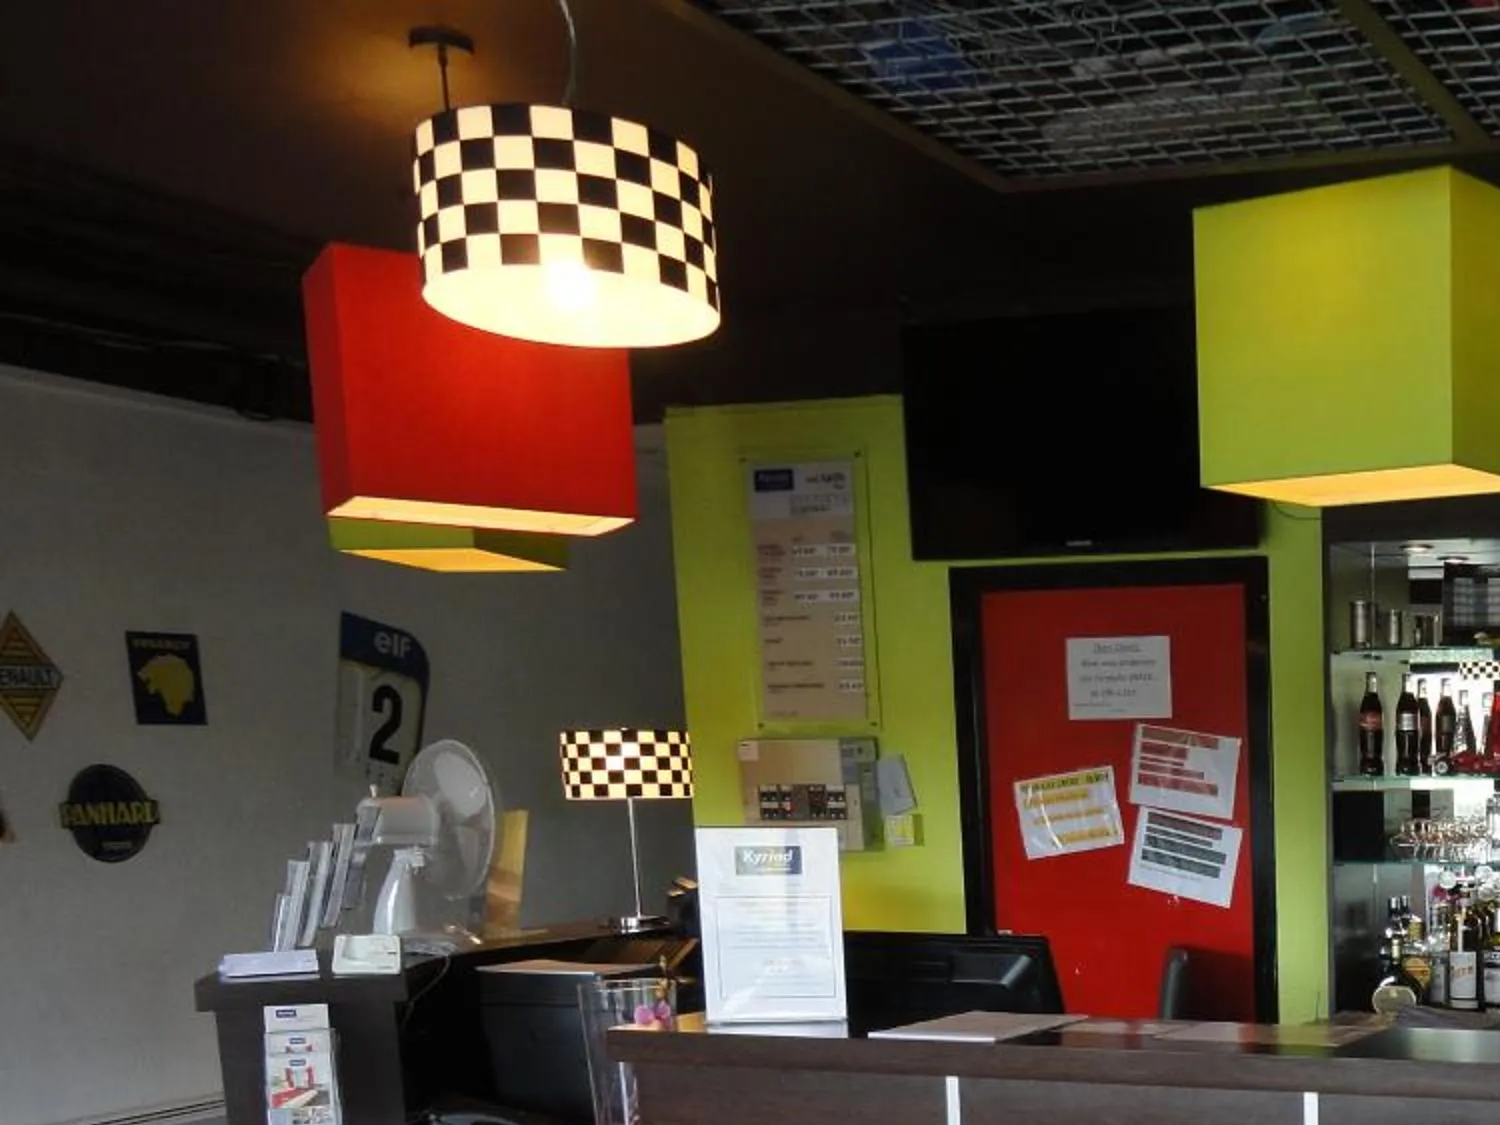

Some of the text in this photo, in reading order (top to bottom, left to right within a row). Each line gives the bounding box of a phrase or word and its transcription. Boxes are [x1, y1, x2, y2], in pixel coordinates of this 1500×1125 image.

[373, 631, 413, 659] elf
[0, 669, 53, 689] ENAULT
[368, 684, 403, 765] 2
[742, 848, 794, 867] Kyriad
